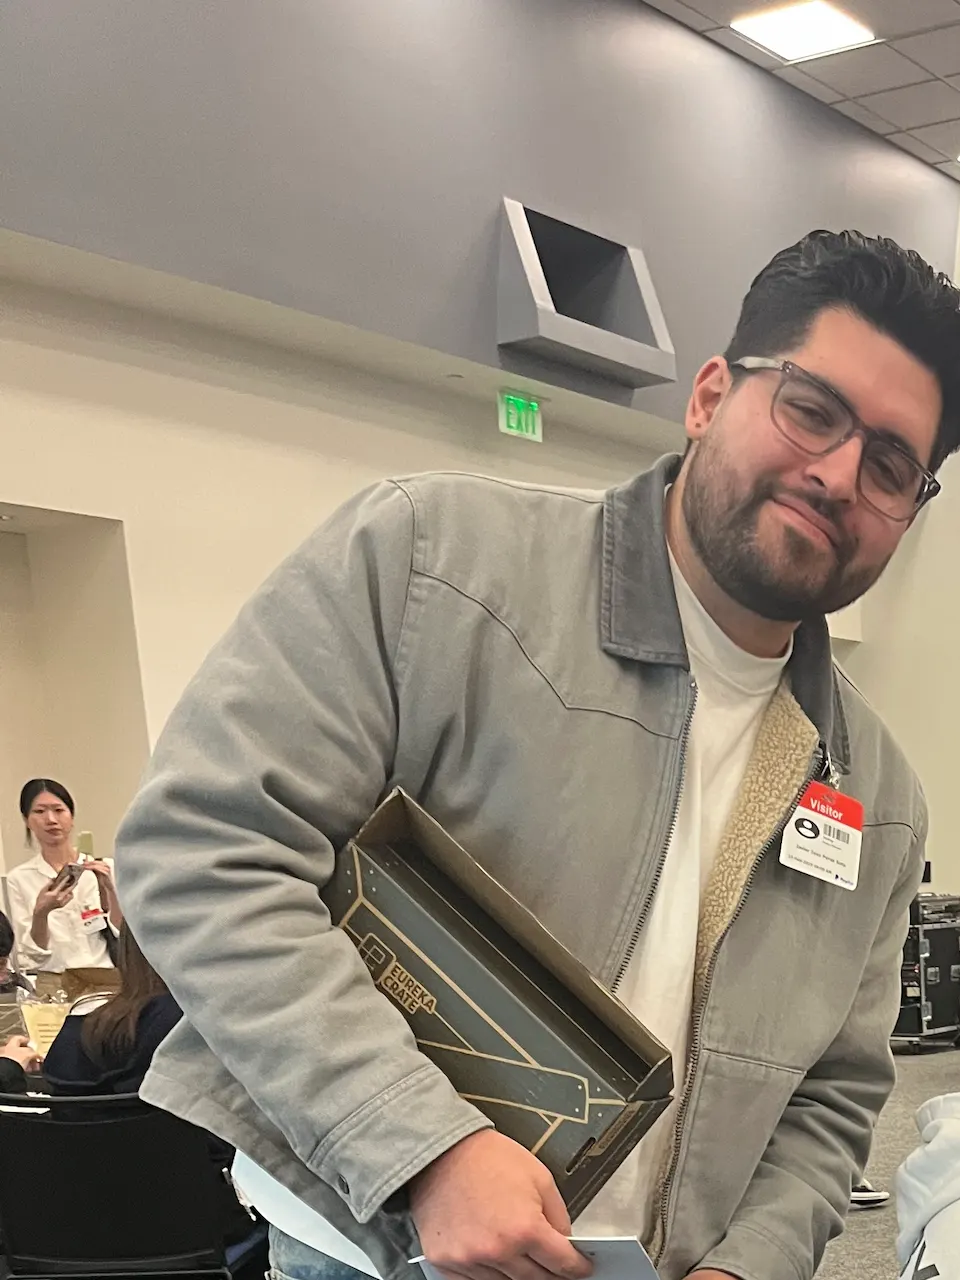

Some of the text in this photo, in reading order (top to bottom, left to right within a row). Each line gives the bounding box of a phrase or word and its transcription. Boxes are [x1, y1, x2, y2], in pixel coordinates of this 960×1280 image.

[810, 797, 843, 820] Visitor
[384, 976, 419, 1012] CRATE
[391, 965, 435, 1011] EUREKA
